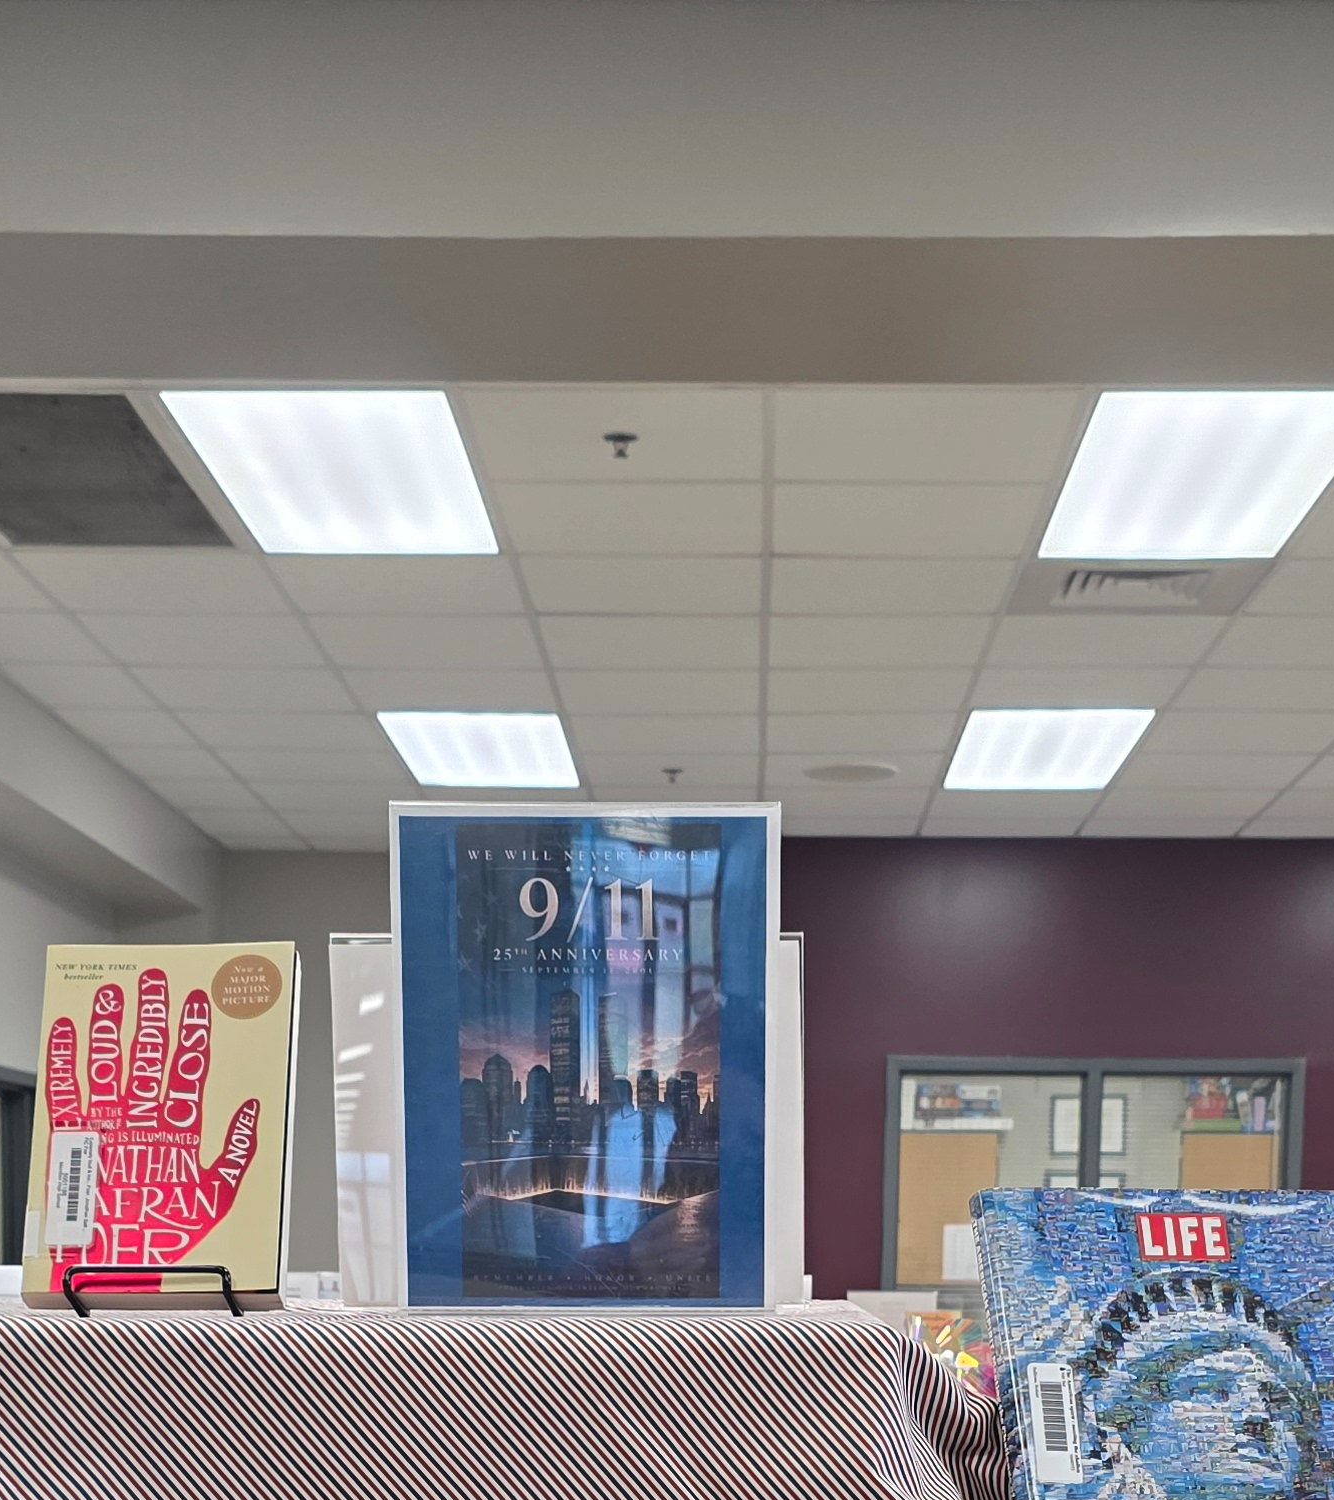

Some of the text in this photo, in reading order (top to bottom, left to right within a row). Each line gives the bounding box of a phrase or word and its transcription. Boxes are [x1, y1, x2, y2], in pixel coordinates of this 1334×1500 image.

[468, 850, 712, 862] WE WILL NEVER FORGET
[519, 876, 660, 943] 9/11
[493, 947, 683, 962] 25TH ANNIVERSARY
[64, 973, 104, 981] bestseller
[223, 984, 270, 995] MOTION
[229, 975, 266, 984] MAJOR
[222, 995, 270, 1005] PICTURE
[91, 990, 122, 1103] LOUD &
[126, 975, 167, 1128] INCREDIBLY
[50, 1024, 81, 1132] EXTREMELY
[164, 1001, 209, 1128] CLOSE
[118, 1131, 200, 1146] IS ILLUMINATED
[218, 1100, 257, 1188] A NOVEL
[1139, 1217, 1227, 1257] LIFE
